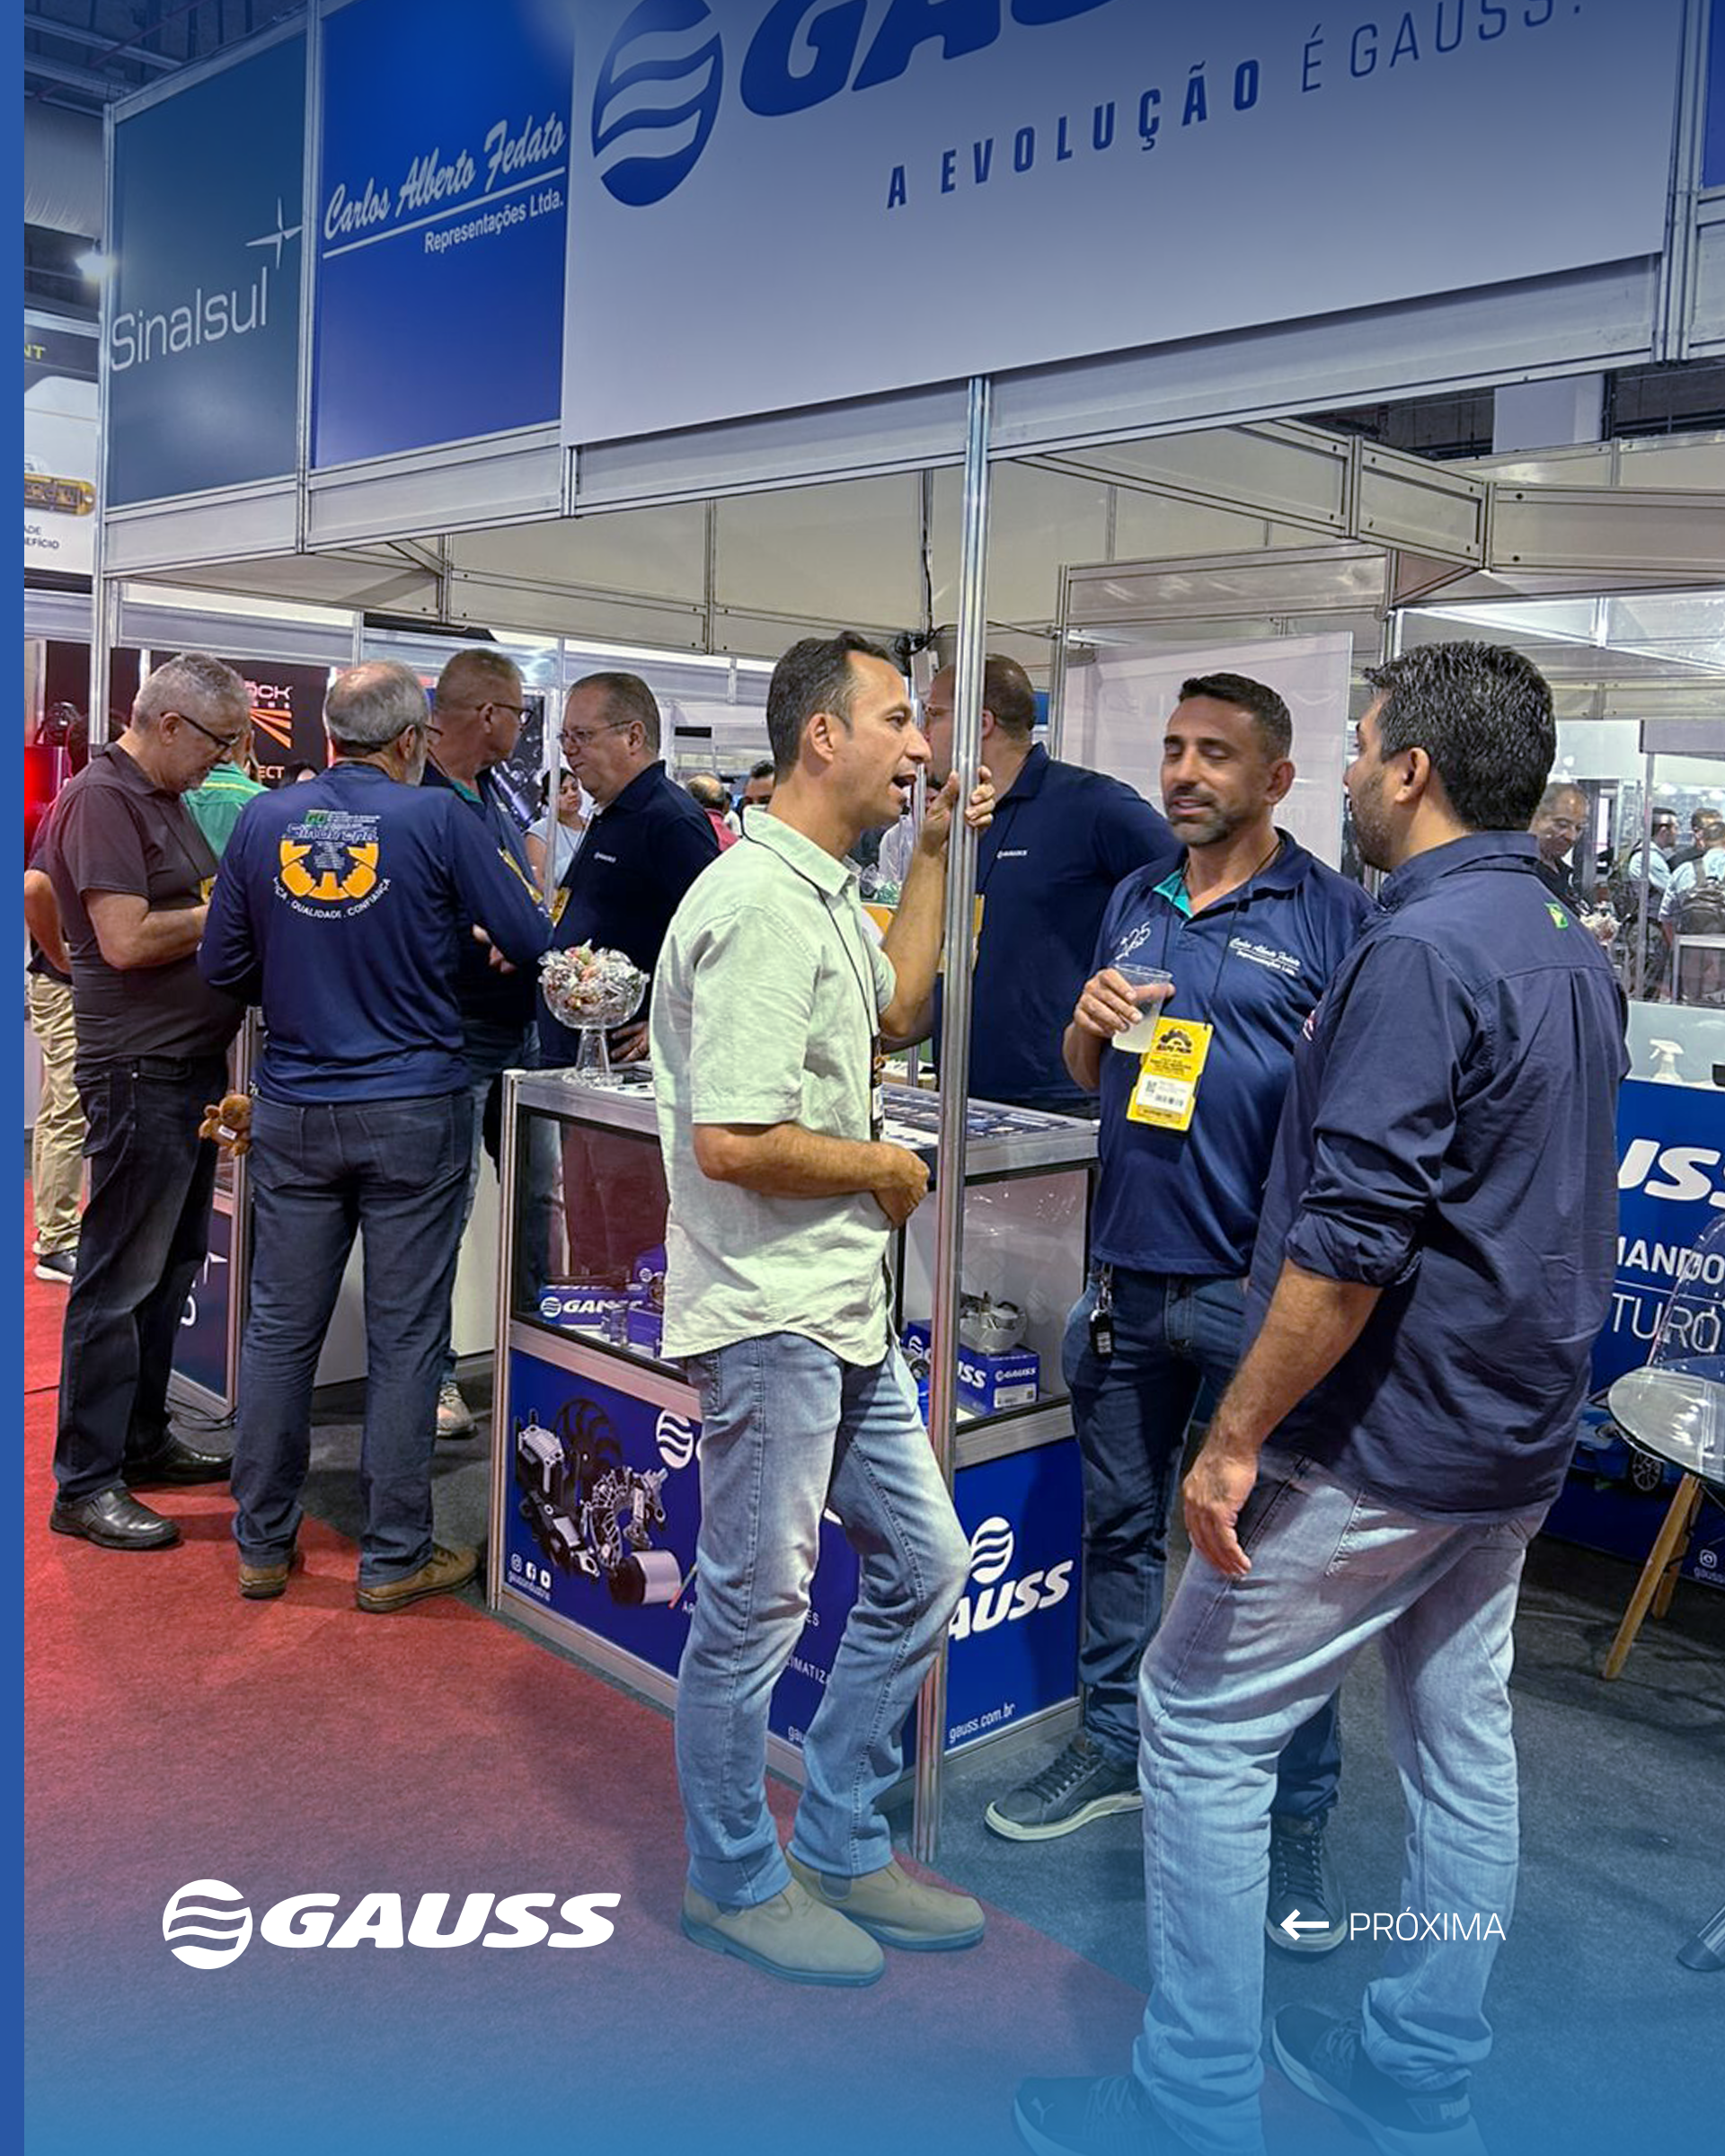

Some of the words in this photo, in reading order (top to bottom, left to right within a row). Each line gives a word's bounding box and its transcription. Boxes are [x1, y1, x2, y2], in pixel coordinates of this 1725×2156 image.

[887, 165, 906, 209] A
[941, 59, 1259, 195] EVOLUÇÃO
[1302, 23, 1323, 93] É
[324, 178, 391, 240] Carlos
[395, 146, 475, 217] Alberto
[483, 112, 566, 192] Fedato
[424, 203, 526, 253] Representações
[529, 187, 563, 217] Ltda.
[111, 266, 268, 371] Sinalsul
[949, 1701, 1015, 1745] gauss.com.br
